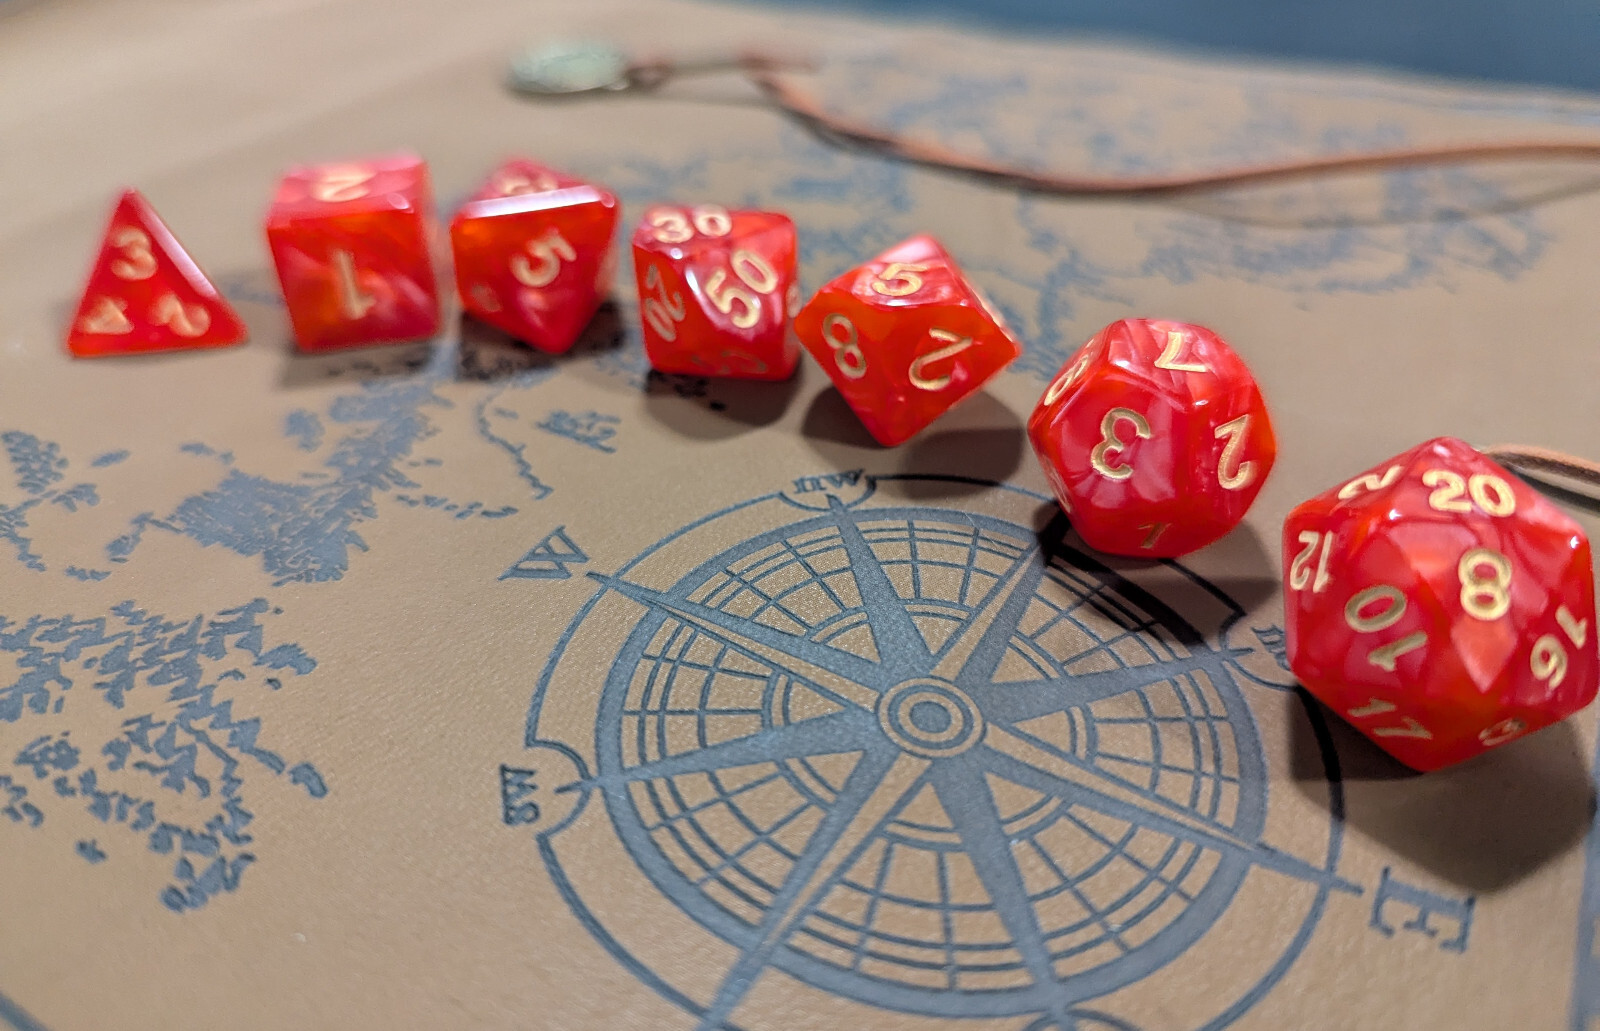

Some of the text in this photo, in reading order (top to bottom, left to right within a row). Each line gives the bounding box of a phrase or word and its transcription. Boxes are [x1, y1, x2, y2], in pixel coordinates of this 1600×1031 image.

[111, 226, 158, 280] 3
[649, 204, 732, 243] 30
[510, 230, 577, 287] 5
[704, 249, 778, 329] 50
[871, 262, 928, 296] 5
[822, 313, 867, 379] 8
[908, 327, 973, 391] 2
[1154, 331, 1207, 373] 7
[1091, 407, 1151, 480] 3
[1214, 414, 1261, 490] 2
[1422, 469, 1516, 517] 20
[498, 525, 590, 580] W
[1290, 530, 1333, 593] 12
[1458, 549, 1513, 621] 8
[1345, 585, 1428, 671] 10
[500, 764, 540, 826] SW
[1369, 867, 1475, 954] E
